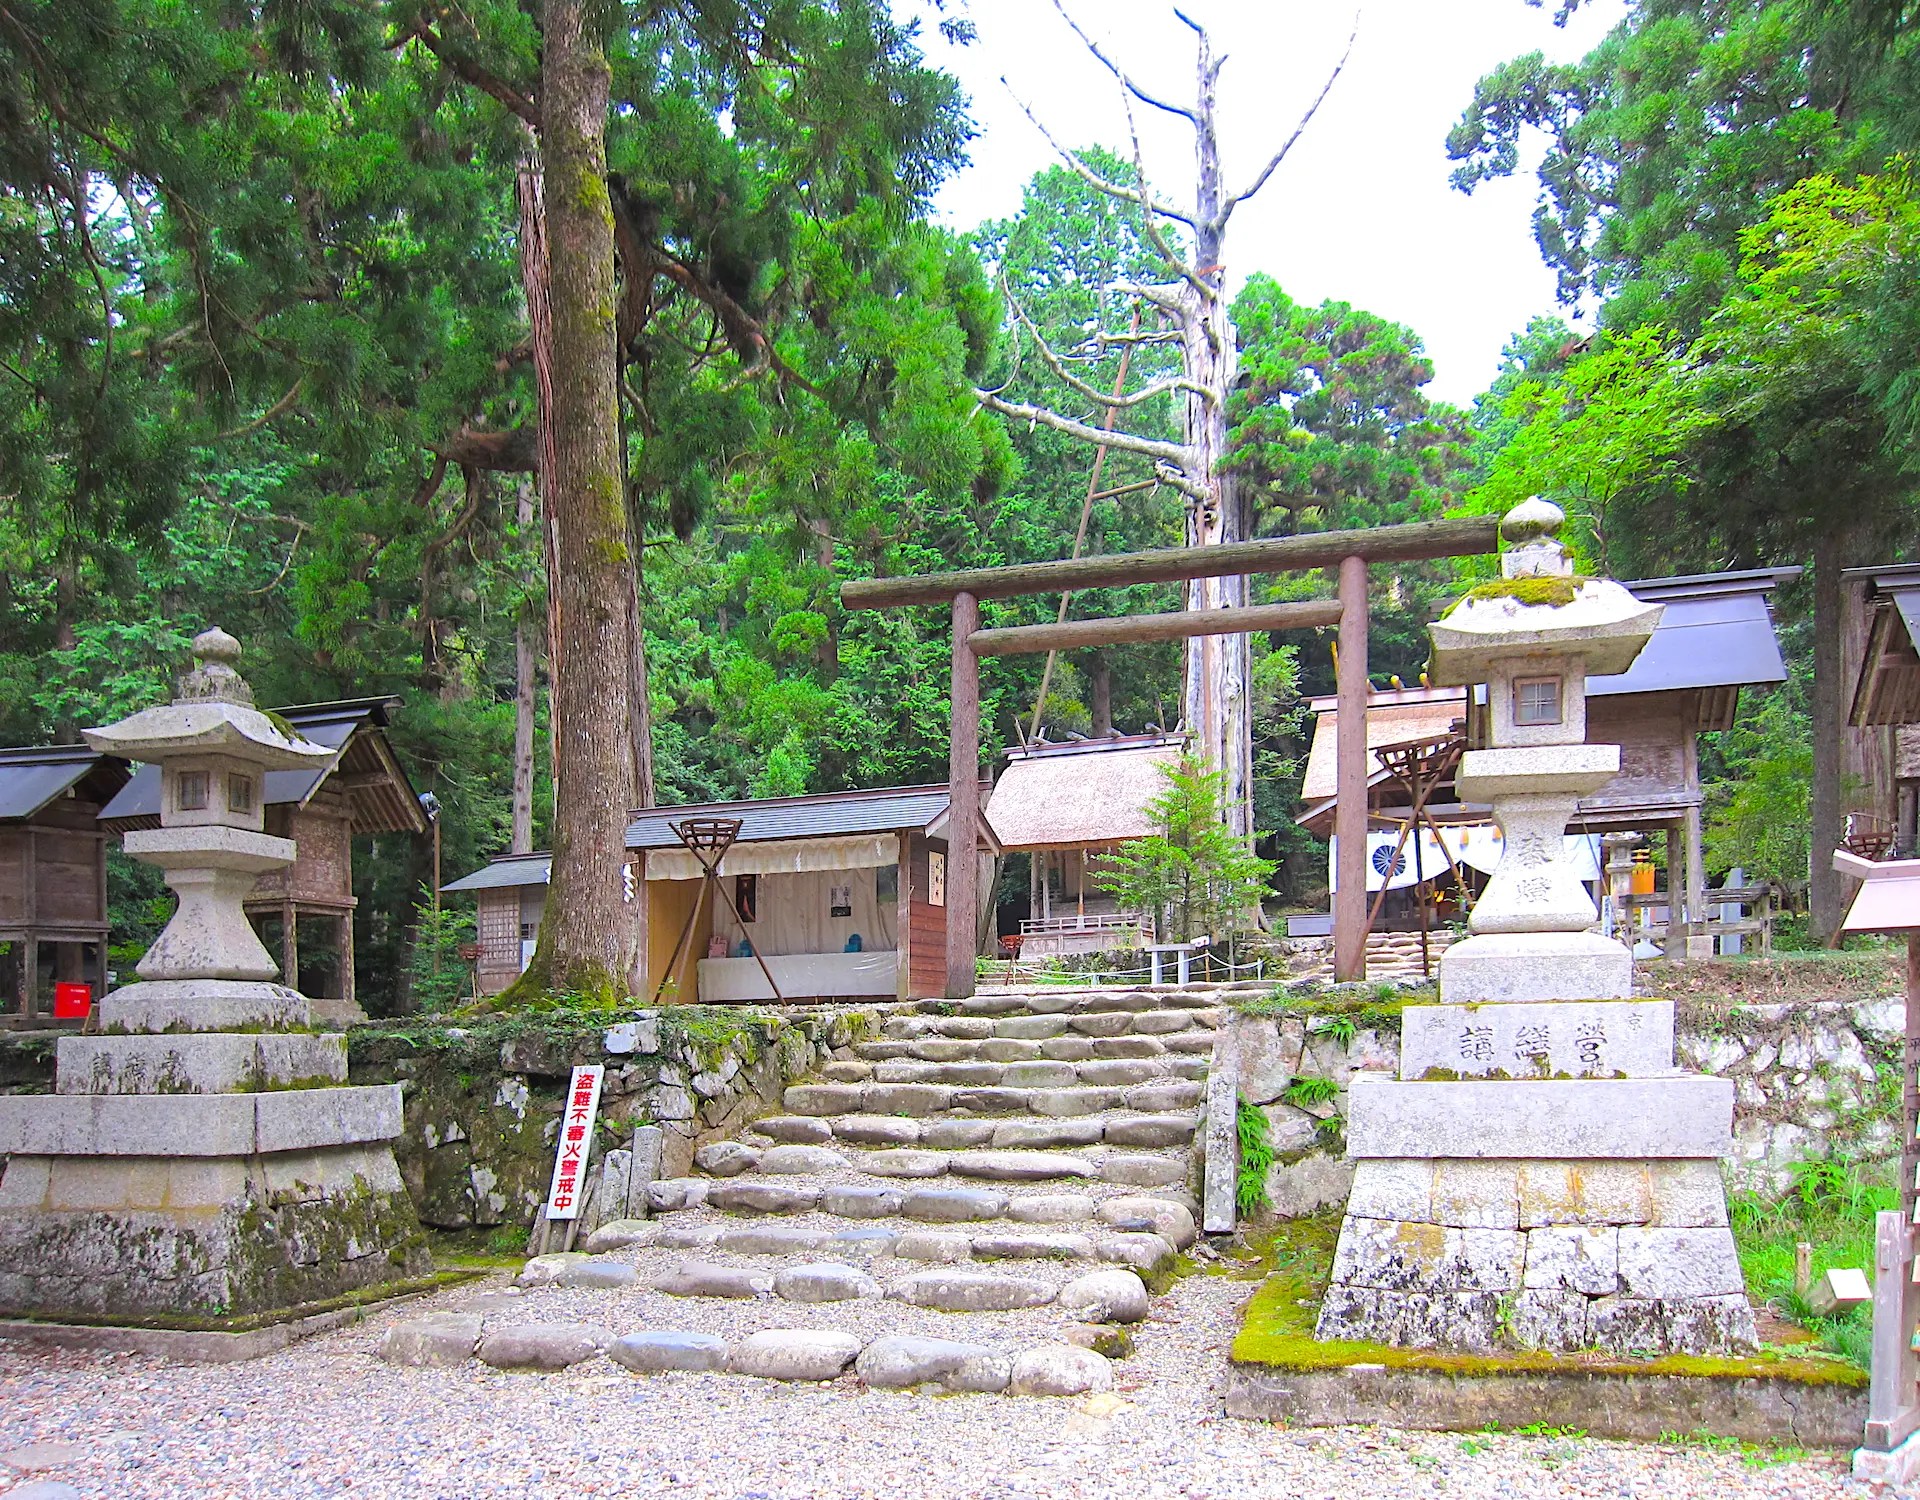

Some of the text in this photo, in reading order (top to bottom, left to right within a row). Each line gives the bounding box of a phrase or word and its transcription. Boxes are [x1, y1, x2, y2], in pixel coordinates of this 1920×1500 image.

[554, 1074, 595, 1211] 盗難不審火警戒中
